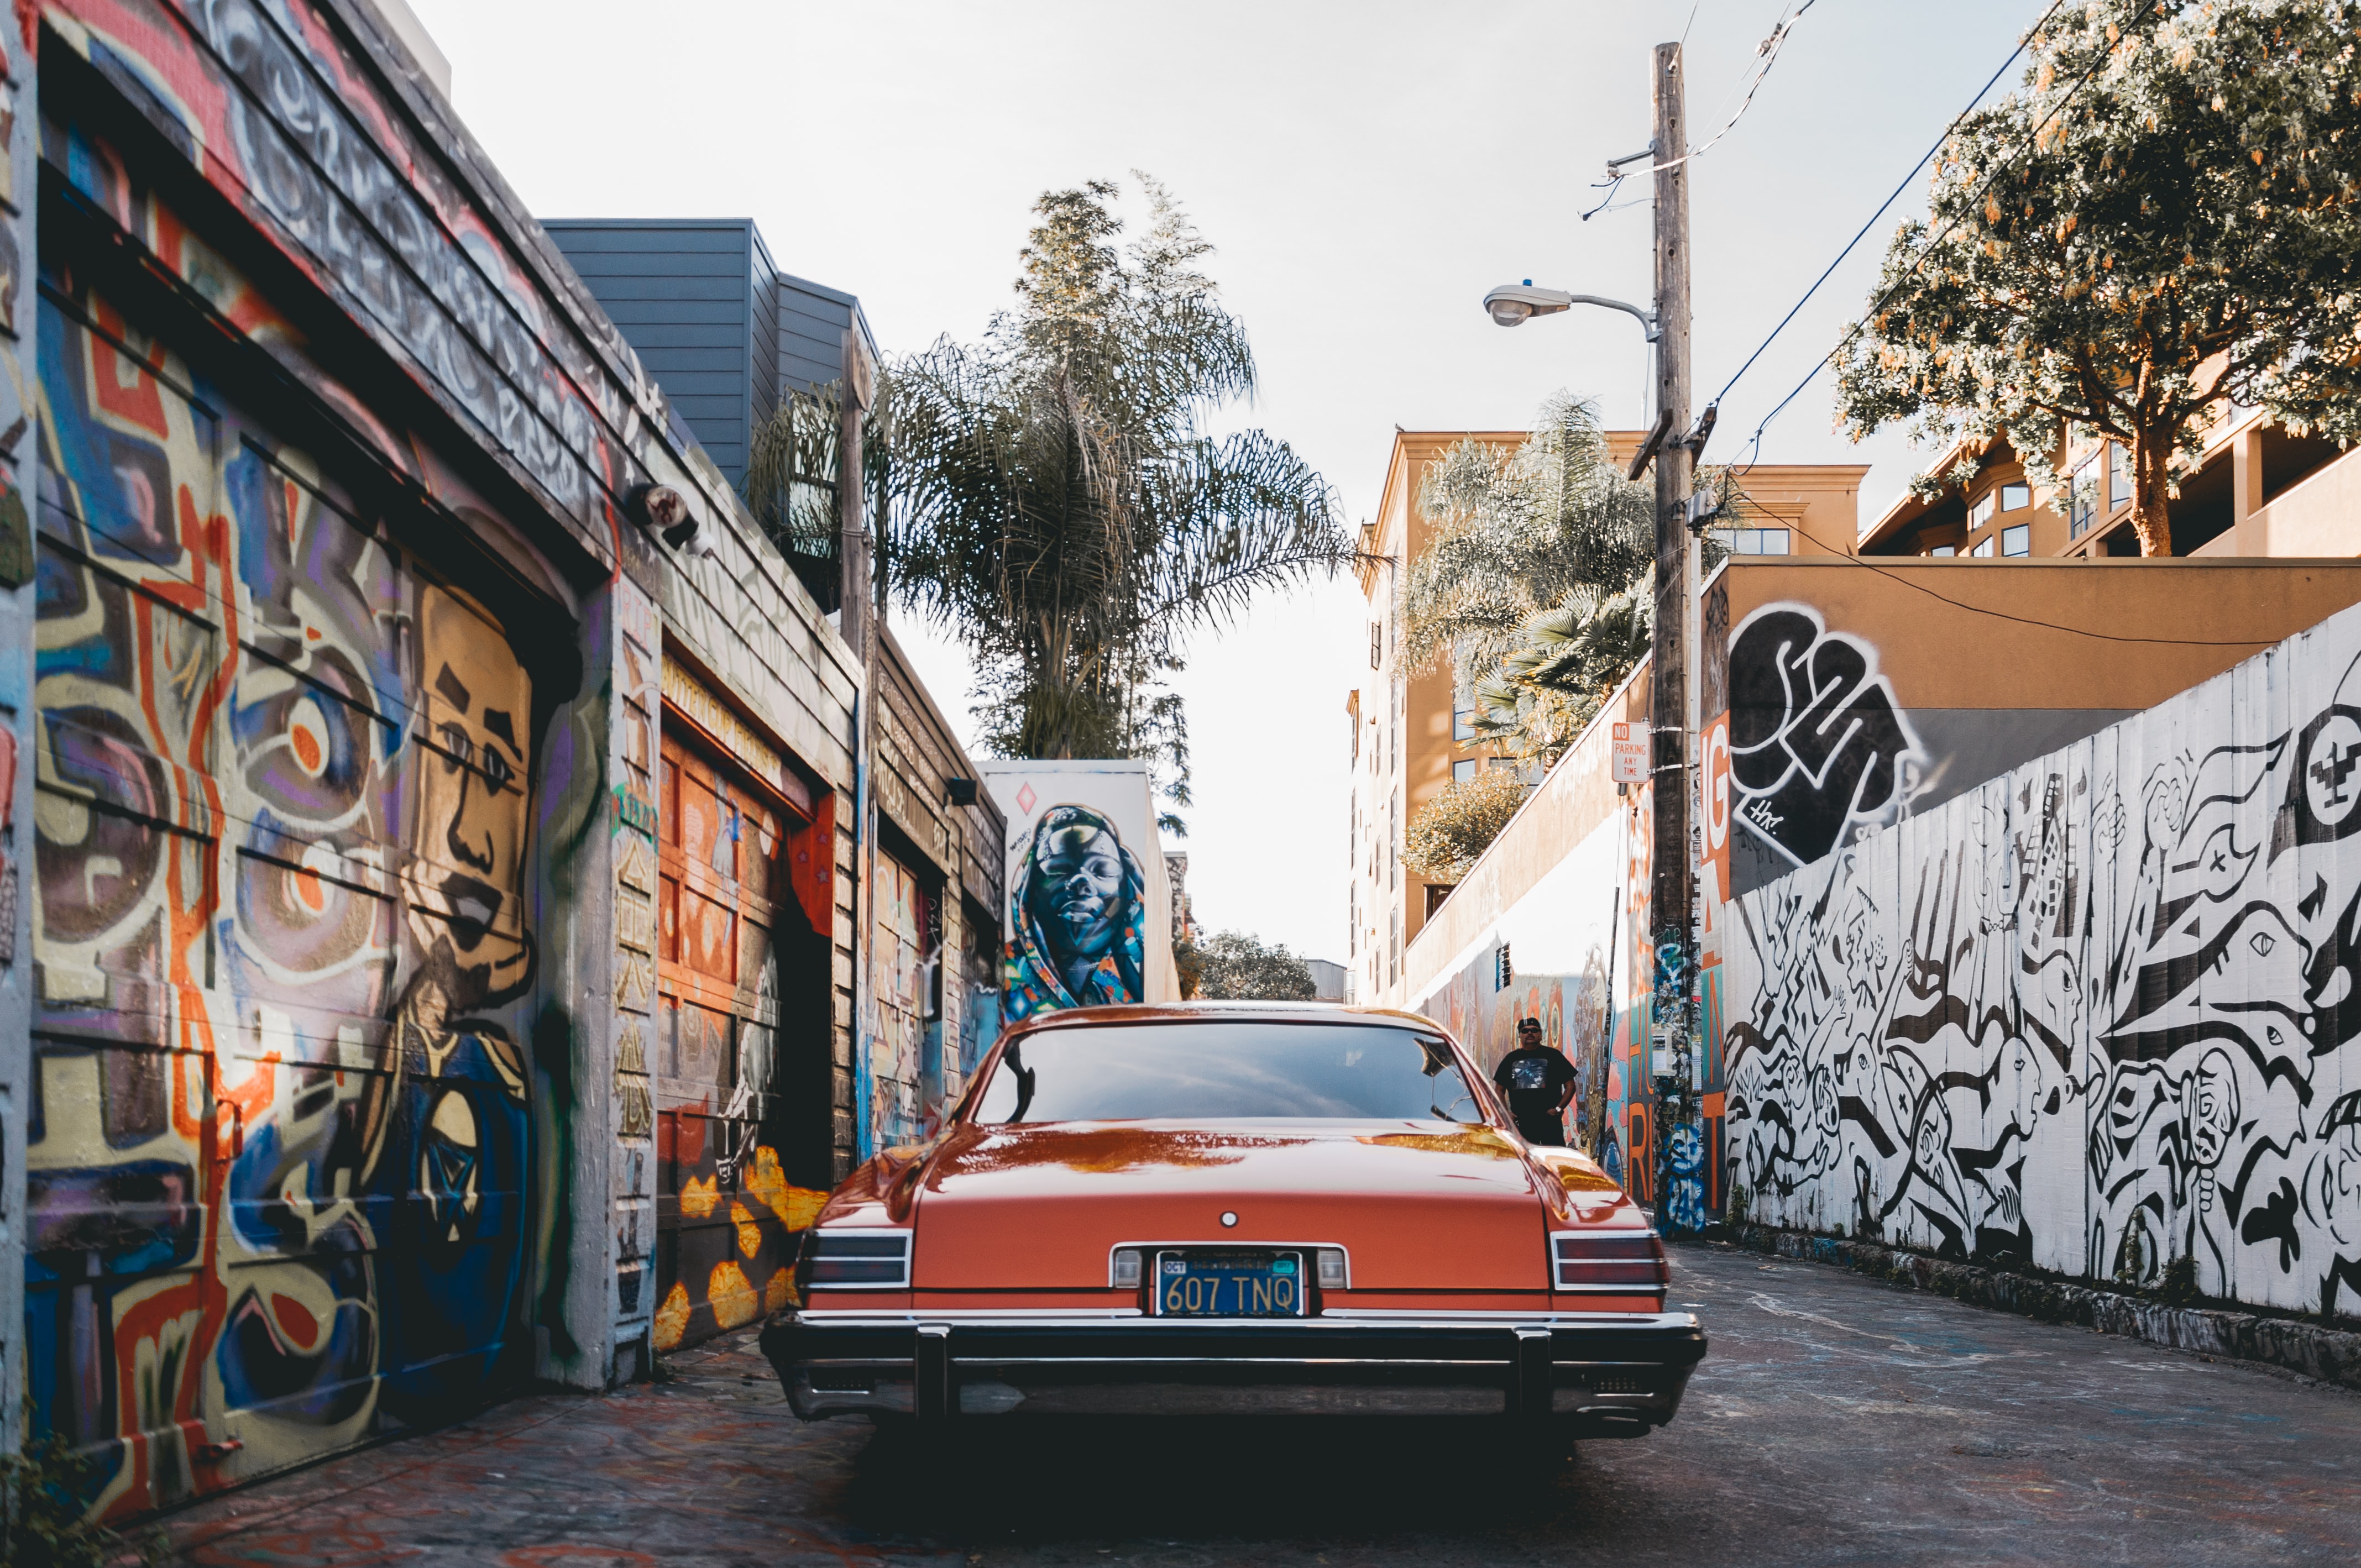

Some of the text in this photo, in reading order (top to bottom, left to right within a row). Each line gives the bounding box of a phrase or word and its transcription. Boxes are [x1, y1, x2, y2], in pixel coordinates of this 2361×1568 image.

[623, 584, 652, 649] RIP
[1615, 725, 1627, 739] NO
[1615, 743, 1646, 756] PARKING
[1624, 767, 1637, 776] TIME
[1166, 1262, 1184, 1272] OCT
[1166, 1276, 1294, 1312] 607 TNQ
